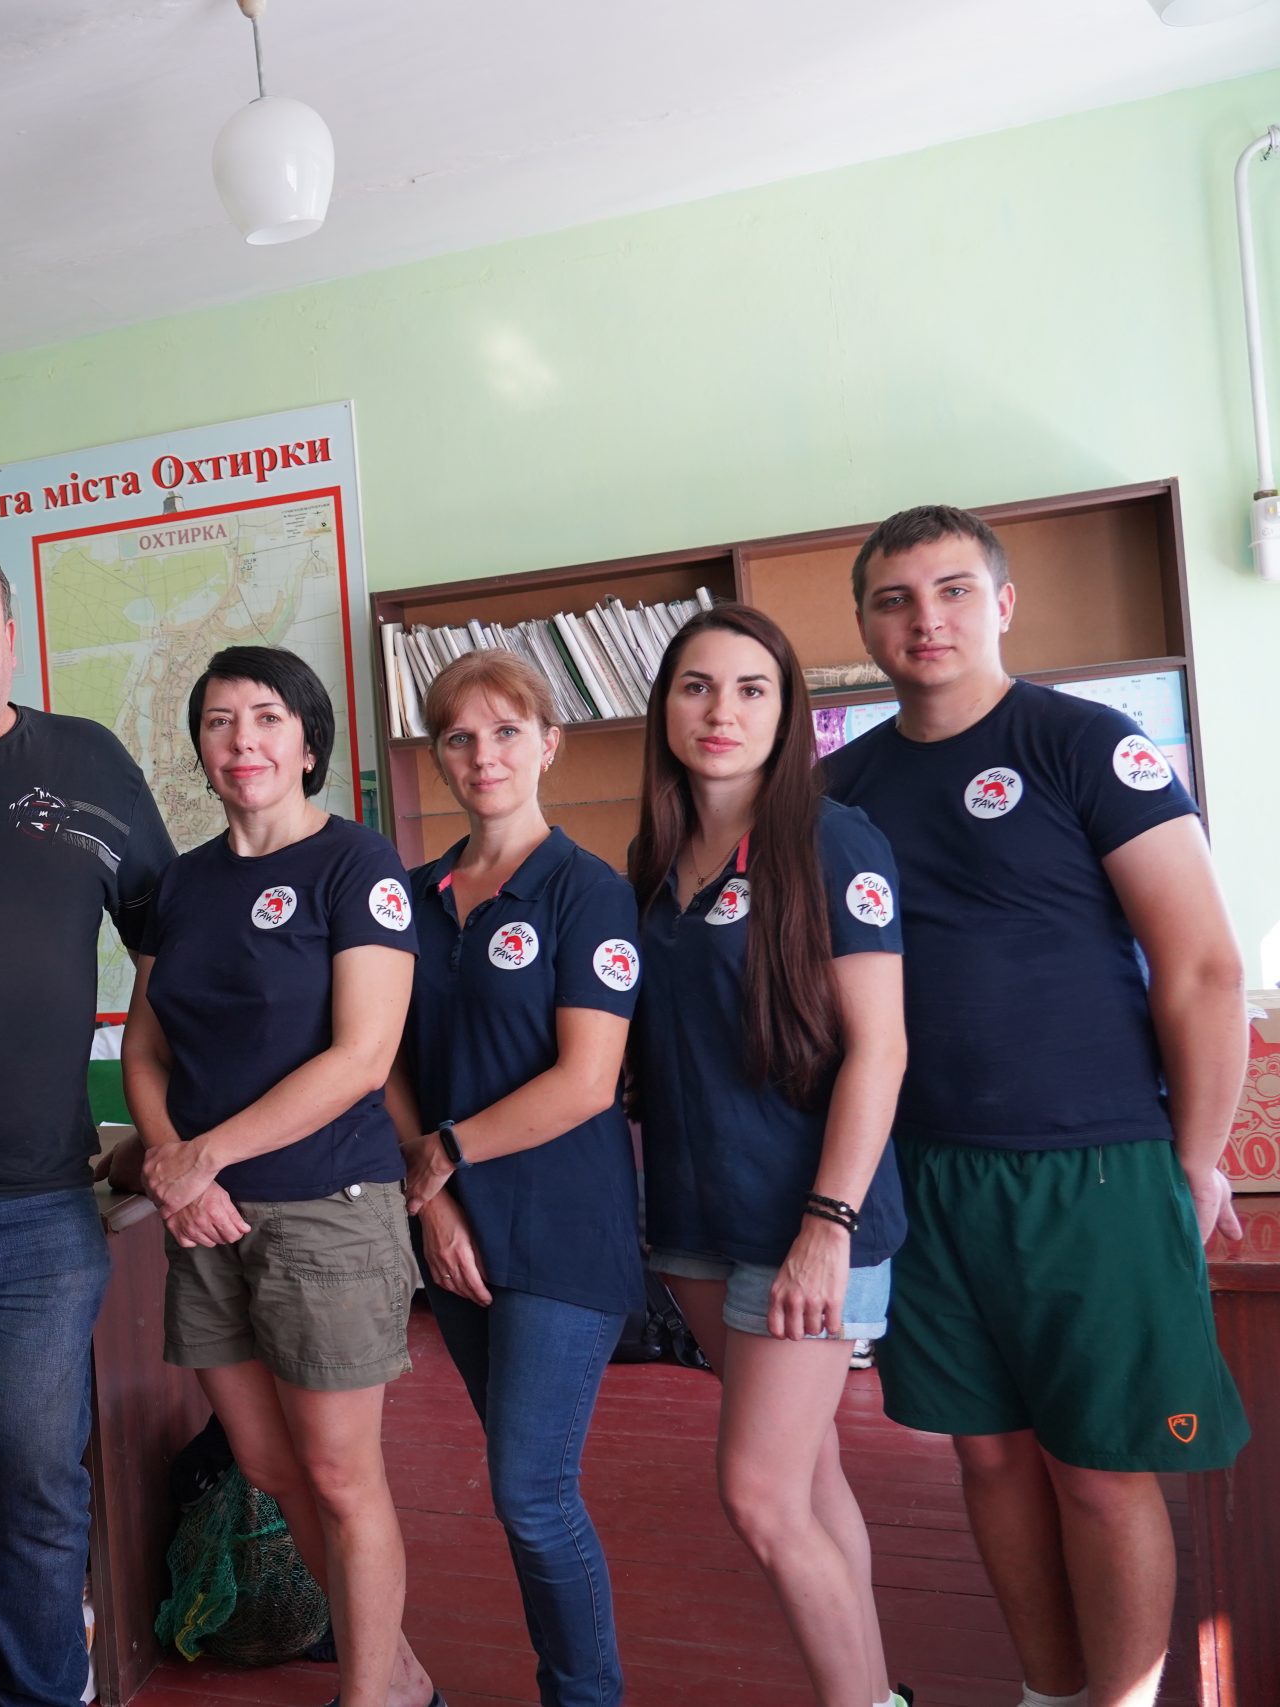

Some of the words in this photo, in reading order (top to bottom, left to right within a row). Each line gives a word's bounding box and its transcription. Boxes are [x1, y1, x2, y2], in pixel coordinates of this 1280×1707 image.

[42, 472, 142, 510] міста
[151, 437, 332, 489] Охтирки
[139, 523, 228, 550] ОХТИРКА
[987, 770, 1016, 788] FOUR
[1128, 770, 1169, 783] PAWS
[971, 797, 1009, 811] PAWS
[271, 888, 293, 907] FOUR
[389, 883, 408, 907] FOUR
[727, 882, 750, 900] FOUR
[862, 876, 890, 898] FOUR
[254, 908, 282, 925] PAWS
[376, 904, 405, 927] PAWS
[509, 924, 533, 947] FOUR
[493, 947, 524, 966] PAWS
[614, 943, 637, 967] FOUR
[601, 964, 632, 987] PAWS
